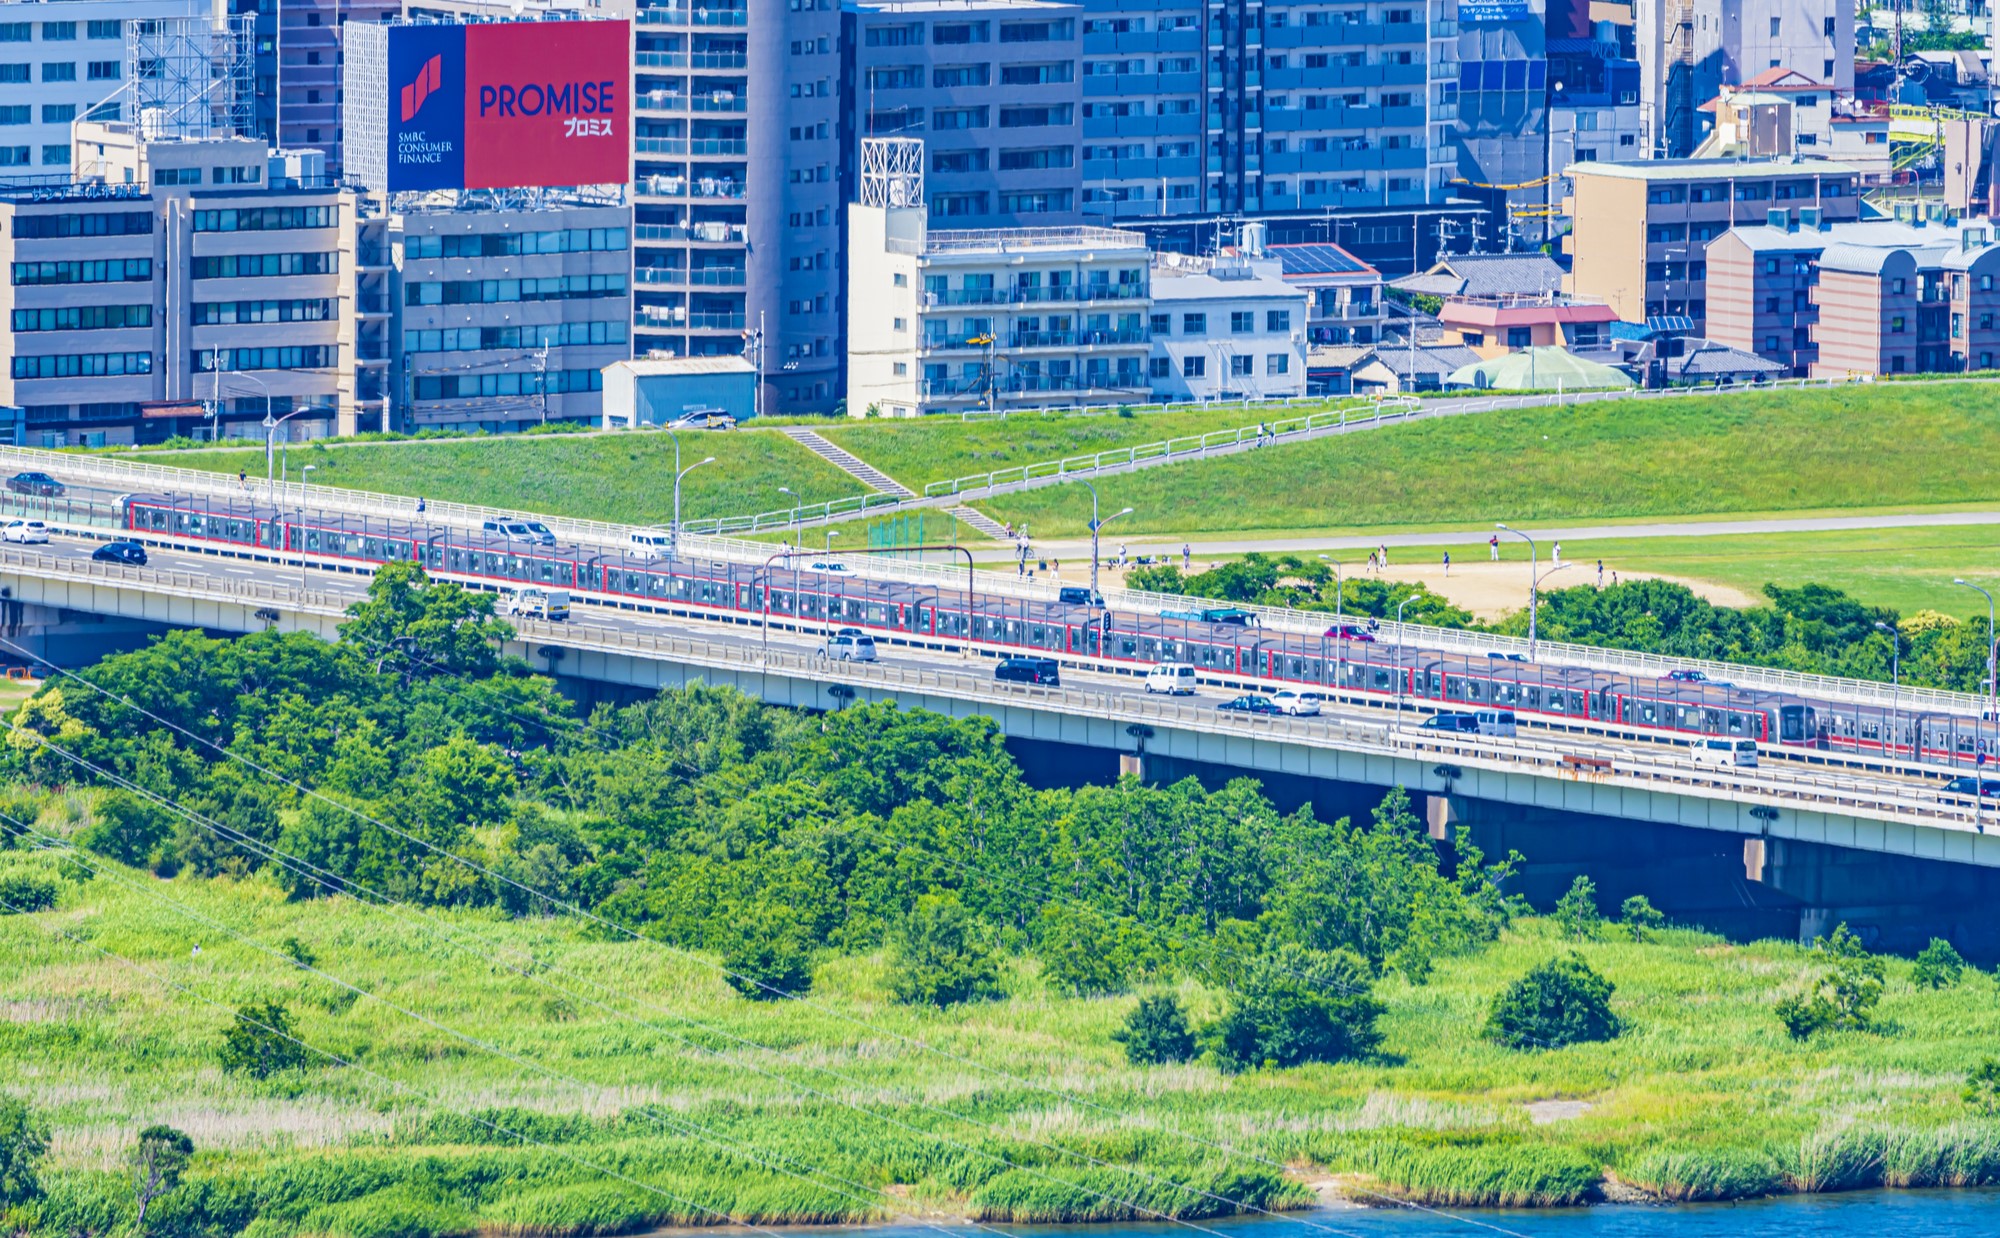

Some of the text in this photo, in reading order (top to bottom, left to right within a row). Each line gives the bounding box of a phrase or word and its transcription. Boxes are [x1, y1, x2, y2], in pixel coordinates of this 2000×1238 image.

[480, 81, 614, 117] PROMISE
[563, 117, 613, 138] プロミス
[398, 131, 426, 143] SMBC
[398, 141, 453, 154] CONSUMER
[398, 152, 442, 164] FINANCE
